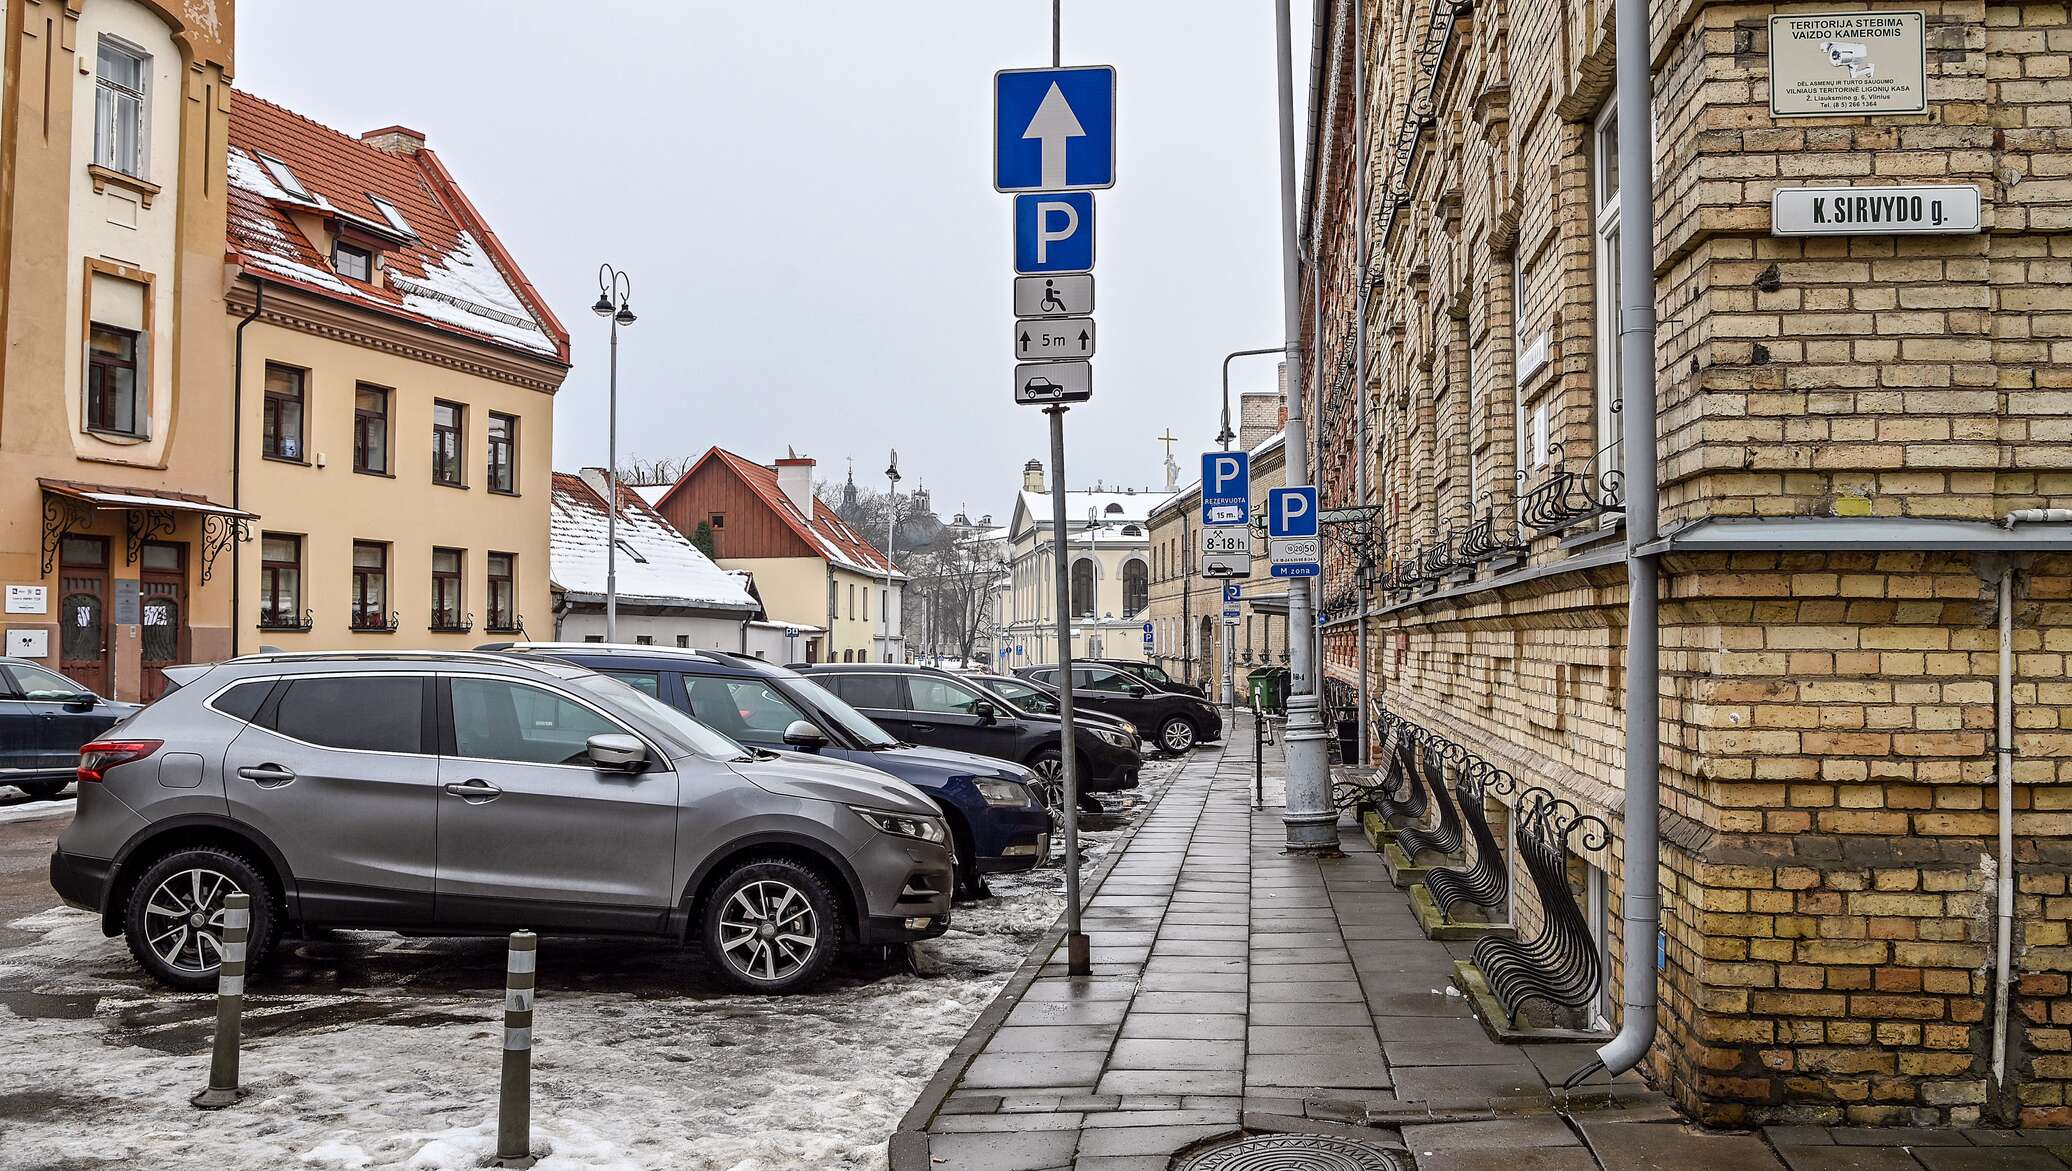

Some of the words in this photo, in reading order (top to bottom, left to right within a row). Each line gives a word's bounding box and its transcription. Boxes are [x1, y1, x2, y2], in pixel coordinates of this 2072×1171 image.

[1790, 20, 1853, 30] TERITORIJA
[1856, 18, 1904, 28] STEBIMA
[1792, 30, 1832, 40] VAIZDO
[1836, 28, 1901, 38] KAMEROMIS
[1813, 196, 1922, 224] K.SIRVYDO
[1932, 200, 1948, 226] g.
[1037, 202, 1079, 264] P
[1042, 334, 1050, 346] 5
[1054, 336, 1066, 346] m
[1216, 458, 1240, 494] P
[1282, 492, 1308, 532] P
[1206, 538, 1234, 550] 8-18
[1238, 538, 1244, 550] h
